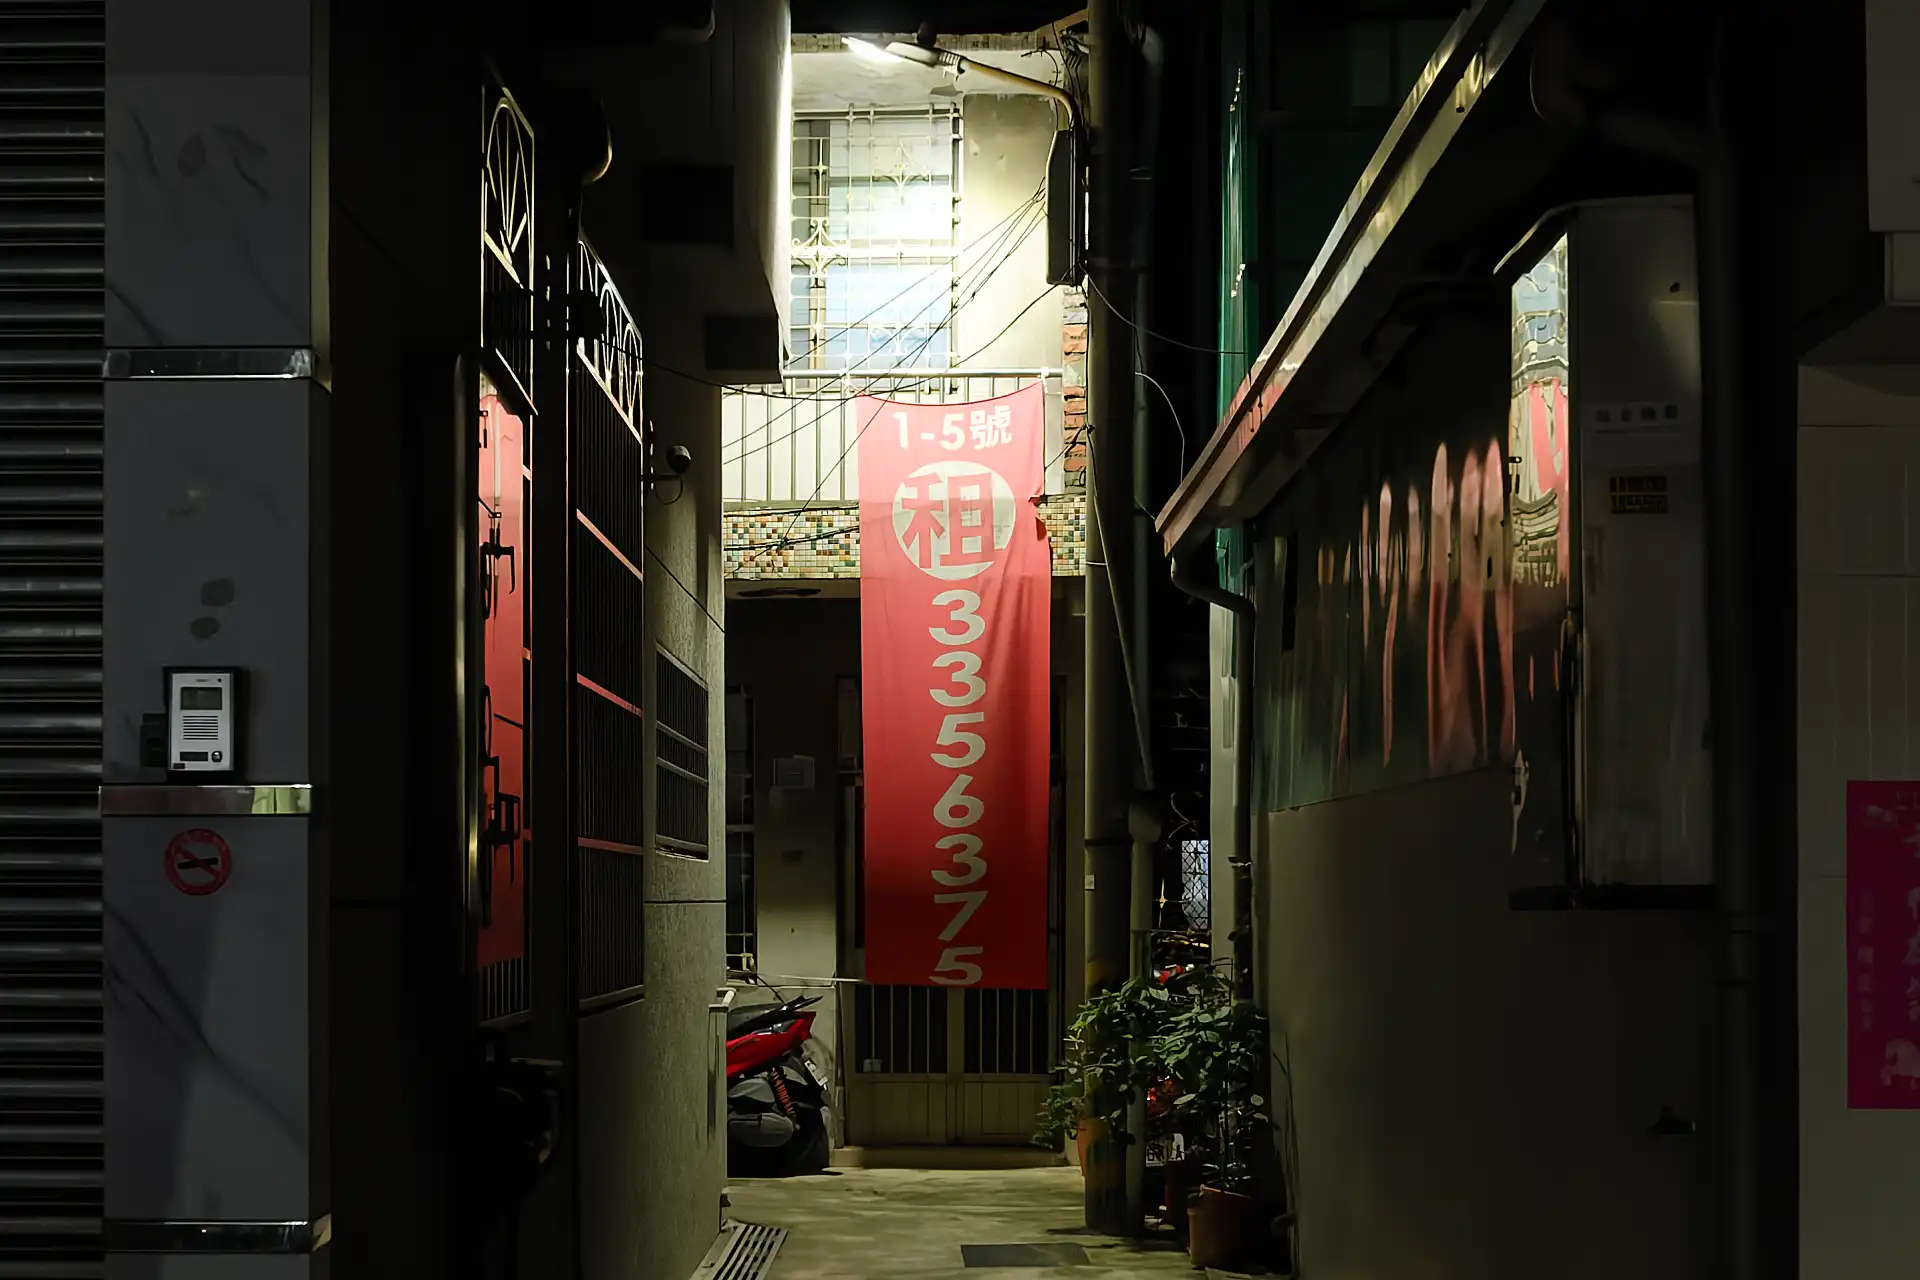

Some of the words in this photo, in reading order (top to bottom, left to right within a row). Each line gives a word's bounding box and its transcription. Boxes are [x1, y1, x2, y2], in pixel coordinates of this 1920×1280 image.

[892, 405, 1012, 450] 1-5號
[902, 472, 995, 569] 租
[928, 589, 988, 986] 3356375
